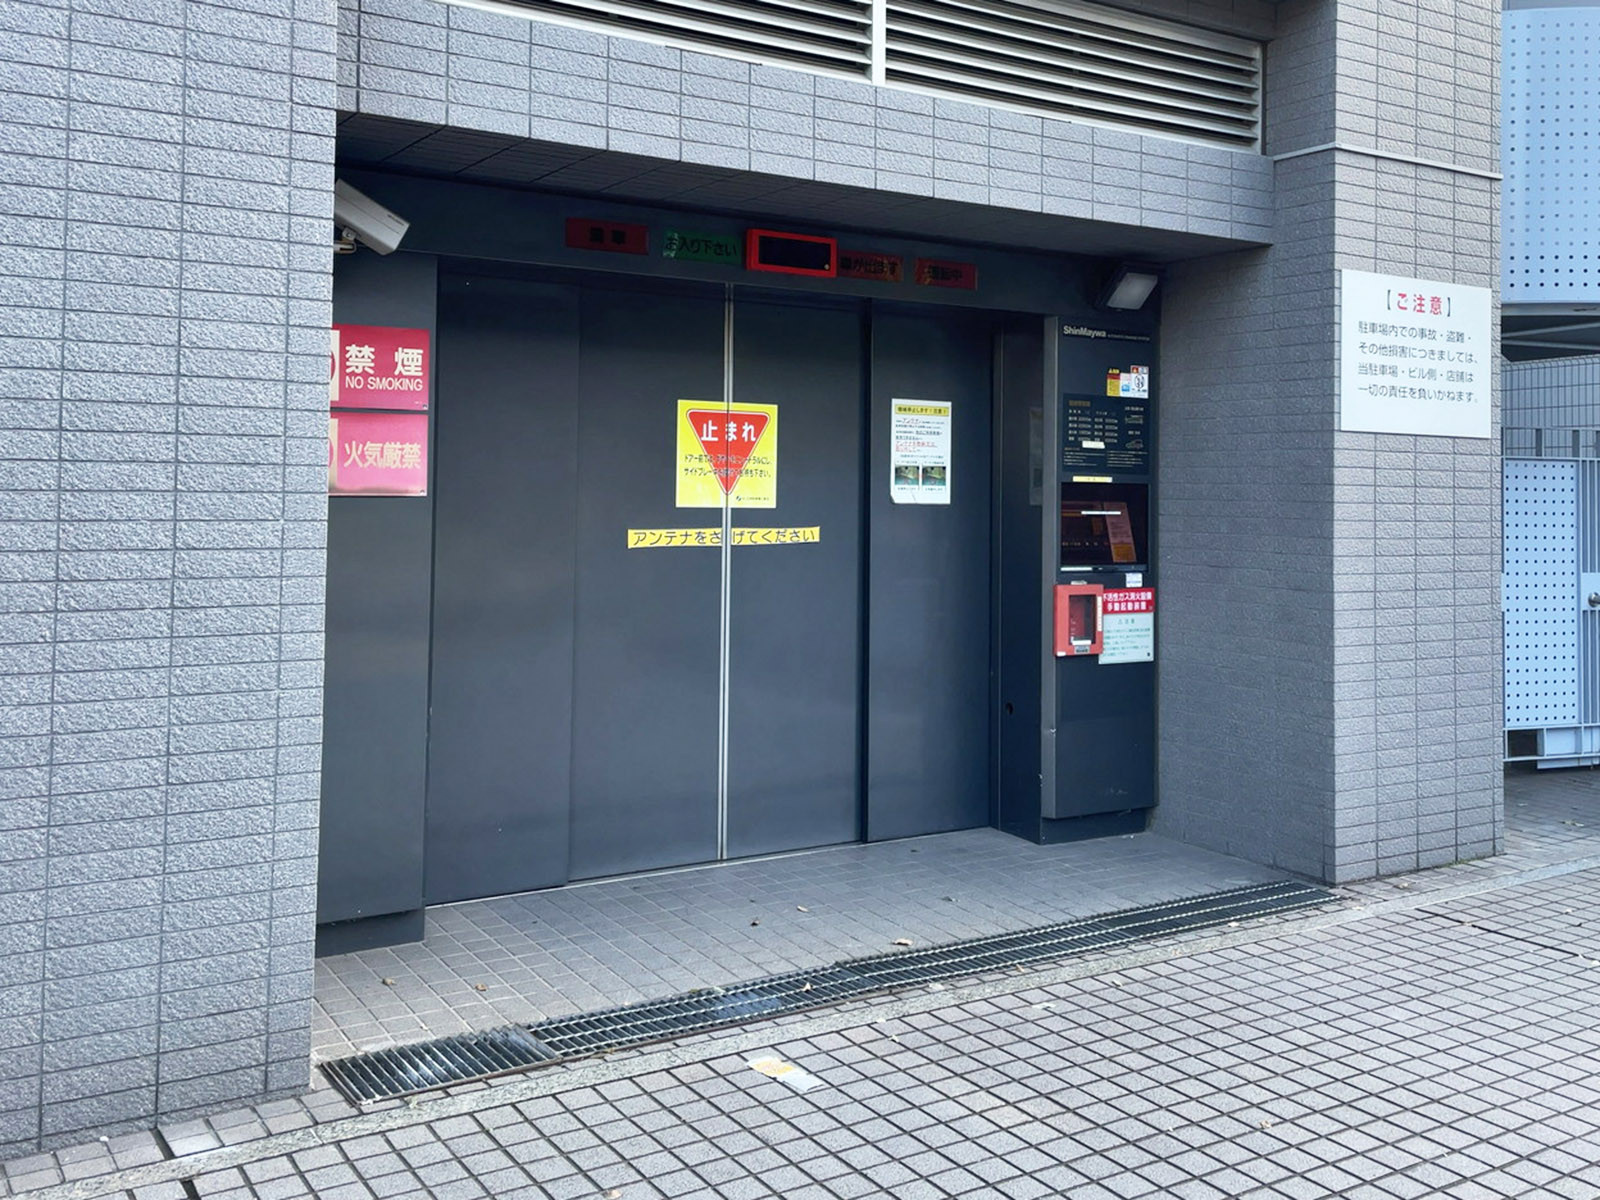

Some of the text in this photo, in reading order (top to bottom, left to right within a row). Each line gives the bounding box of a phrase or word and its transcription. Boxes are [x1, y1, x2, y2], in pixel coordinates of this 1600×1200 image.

[665, 236, 737, 258] お入り下さい
[1063, 325, 1107, 339] ShinMaywa
[1358, 341, 1478, 365] その他損害につきましては、
[345, 376, 424, 392] NO SMOKING
[1358, 383, 1478, 404] 一切の責任を負いかねます。
[700, 419, 757, 442] 止まれ
[343, 440, 421, 469] 火気厳禁
